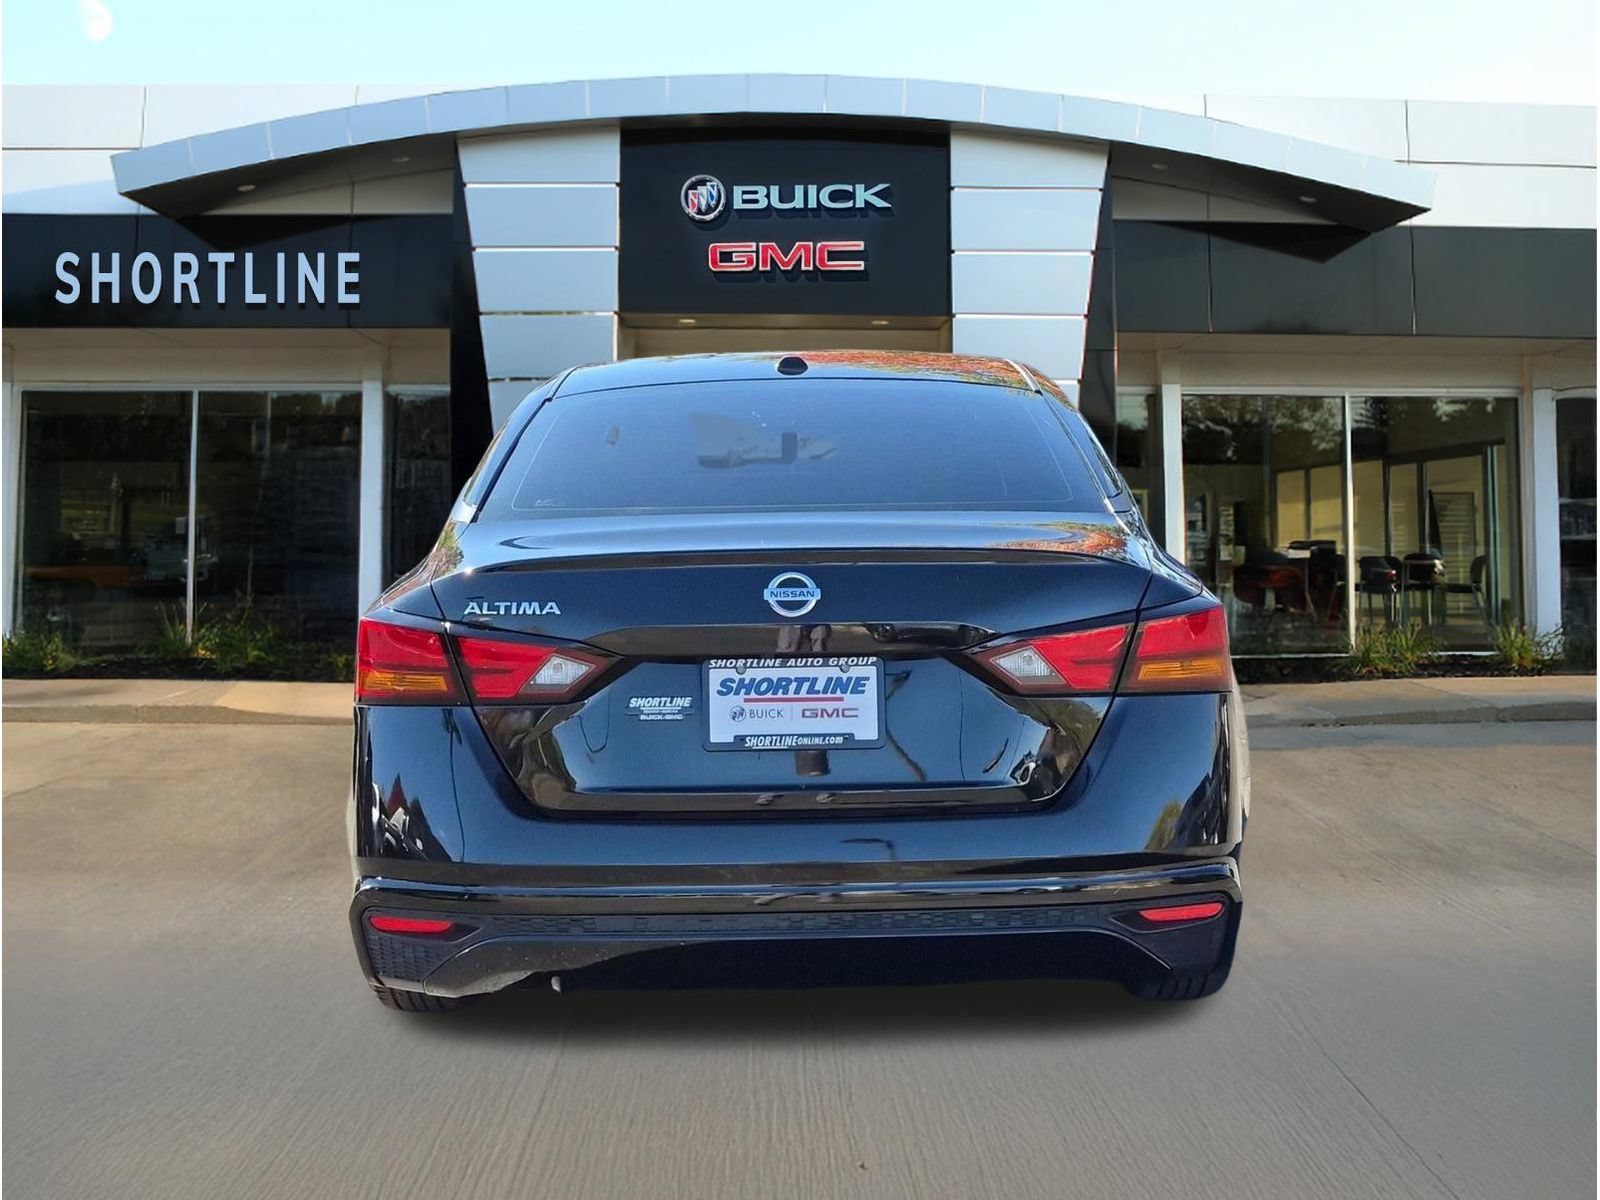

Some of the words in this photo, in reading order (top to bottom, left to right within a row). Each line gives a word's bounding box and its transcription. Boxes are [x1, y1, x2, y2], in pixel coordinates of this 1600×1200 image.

[733, 183, 892, 209] BUICK
[709, 241, 865, 271] GMC
[55, 252, 360, 304] SHORTLINE
[770, 589, 815, 599] NISSAN
[464, 601, 561, 615] ALTIMA
[709, 658, 782, 668] SHORTLINE
[787, 658, 822, 667] AUTO
[829, 656, 877, 666] GROUP
[716, 676, 870, 696] SHORTLINE
[629, 697, 692, 708] SHORTLINE
[749, 709, 784, 719] BUICK
[801, 708, 859, 718] GMC
